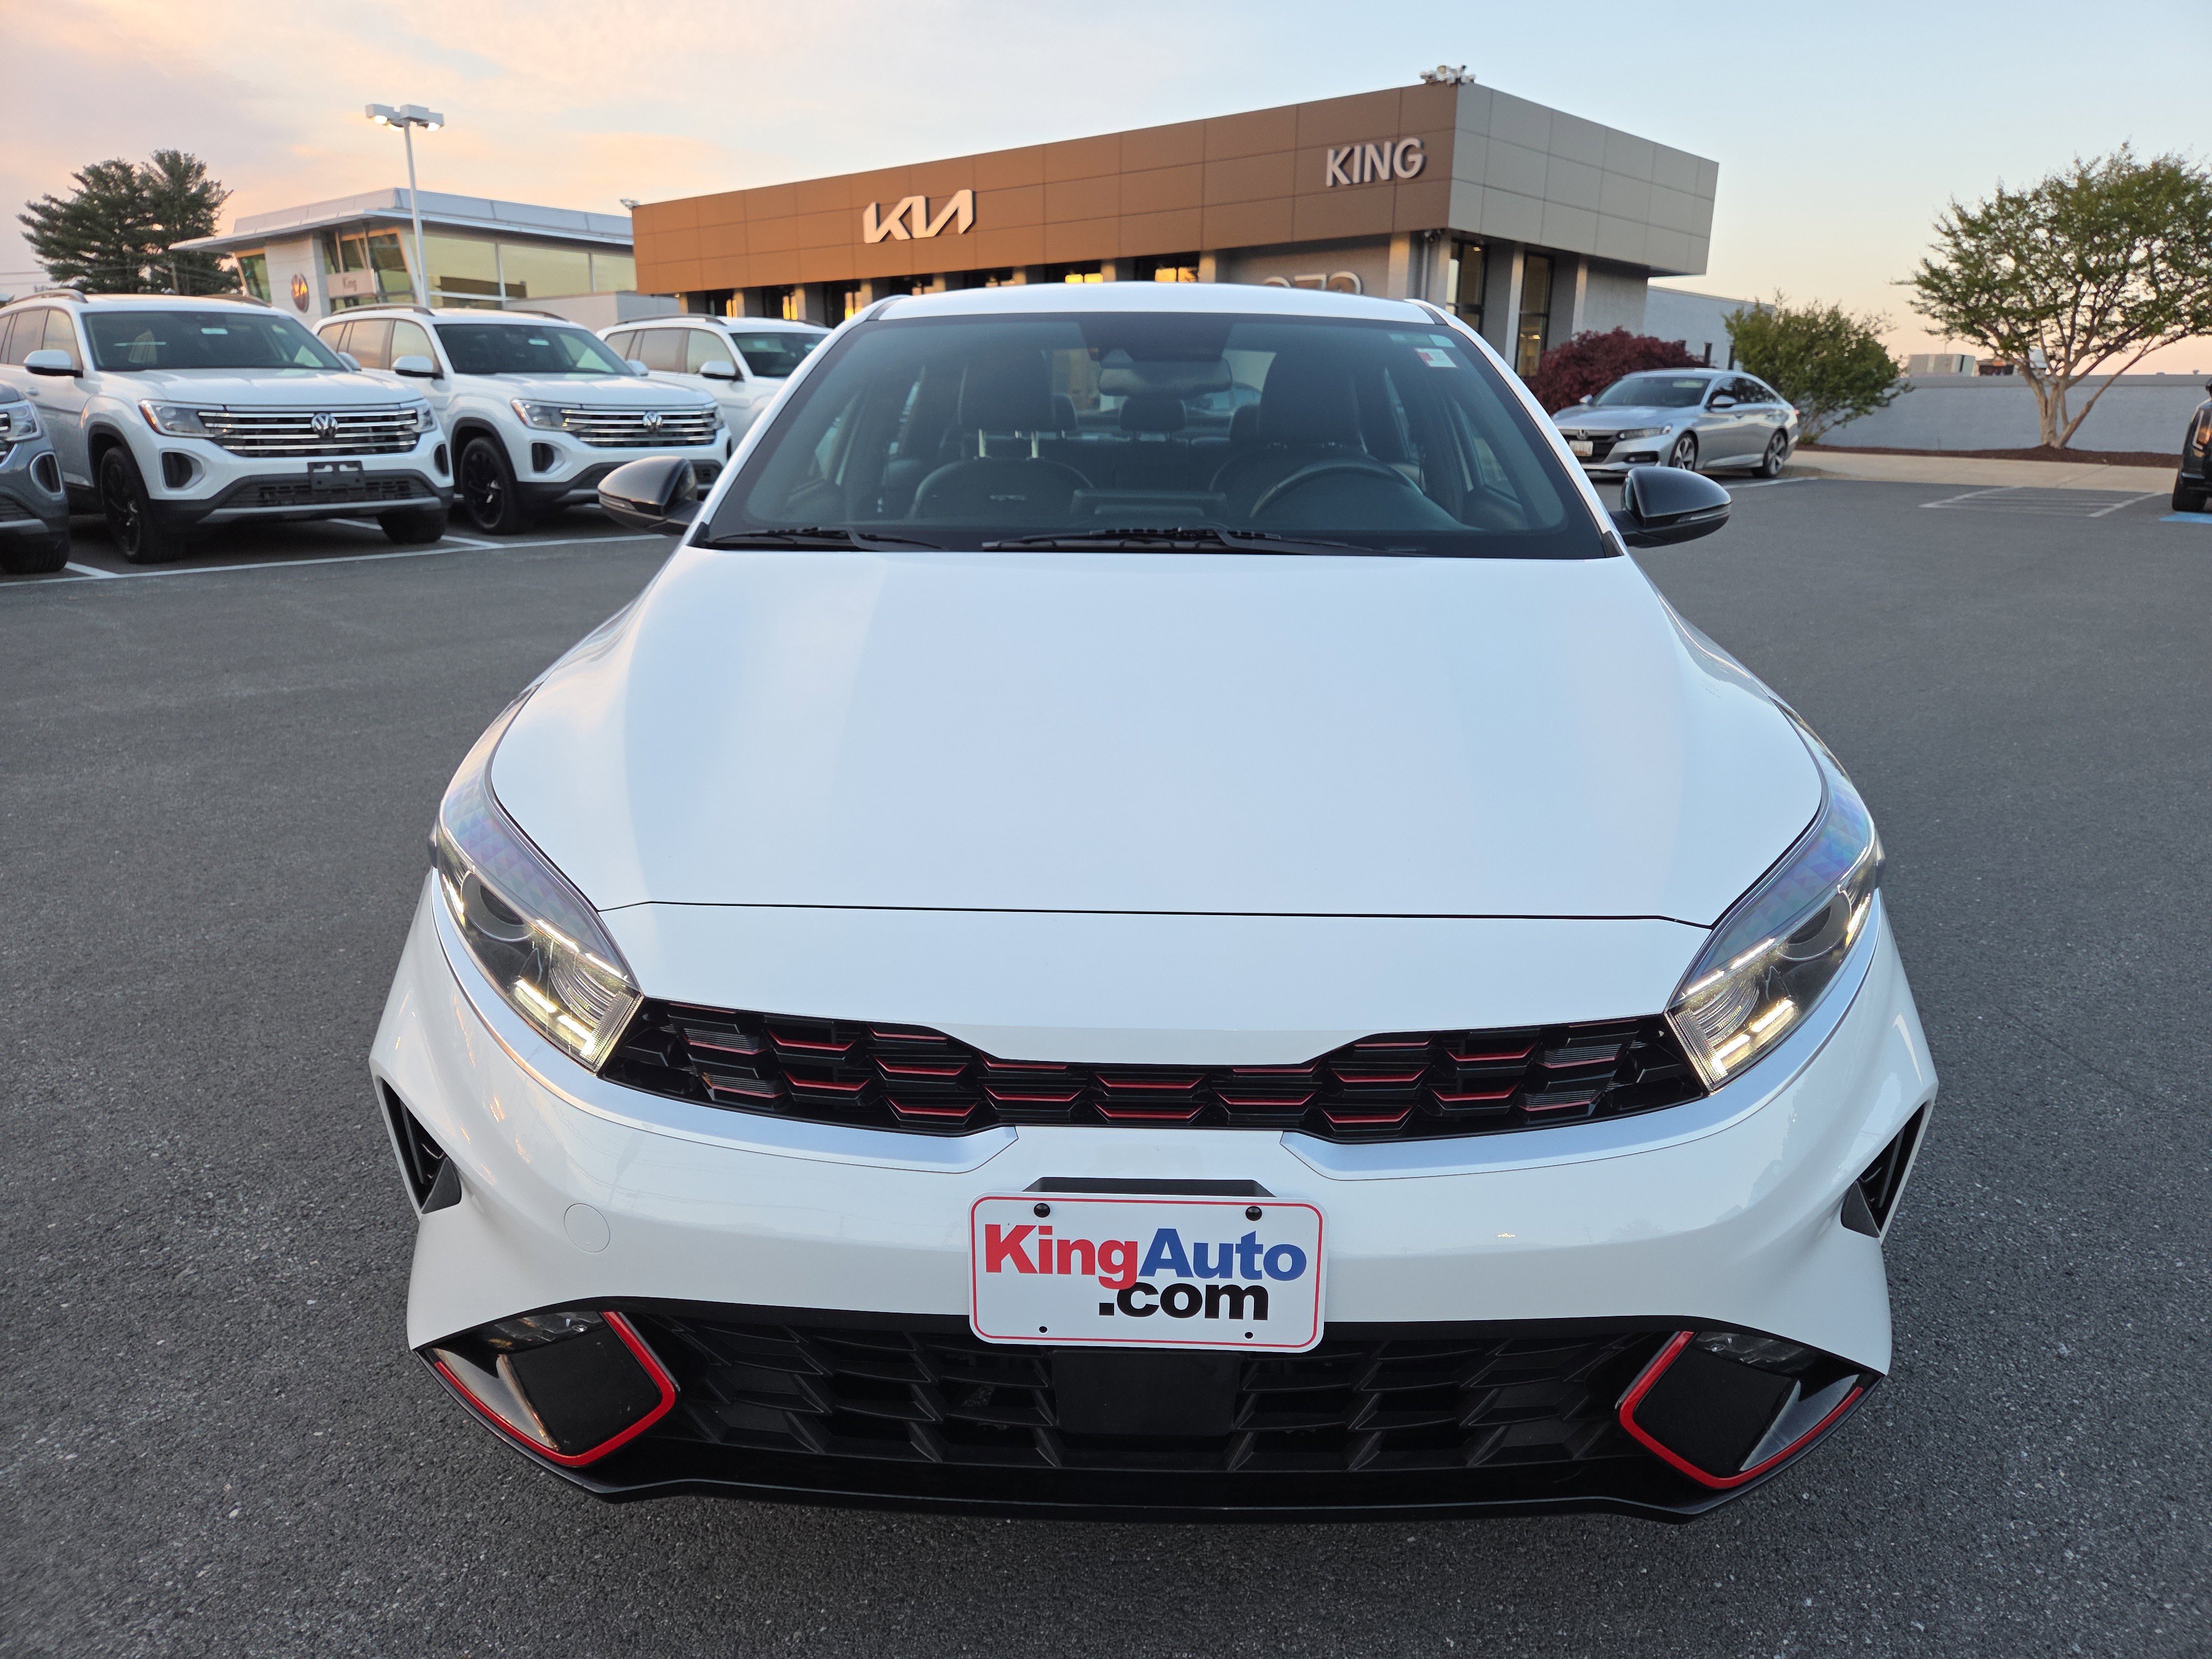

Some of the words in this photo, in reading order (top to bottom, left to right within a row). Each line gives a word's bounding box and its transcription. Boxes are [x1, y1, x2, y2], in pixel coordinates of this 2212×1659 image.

[1326, 137, 1425, 187] KING
[985, 1224, 1307, 1290] KingAuto
[1098, 1282, 1269, 1321] .com
